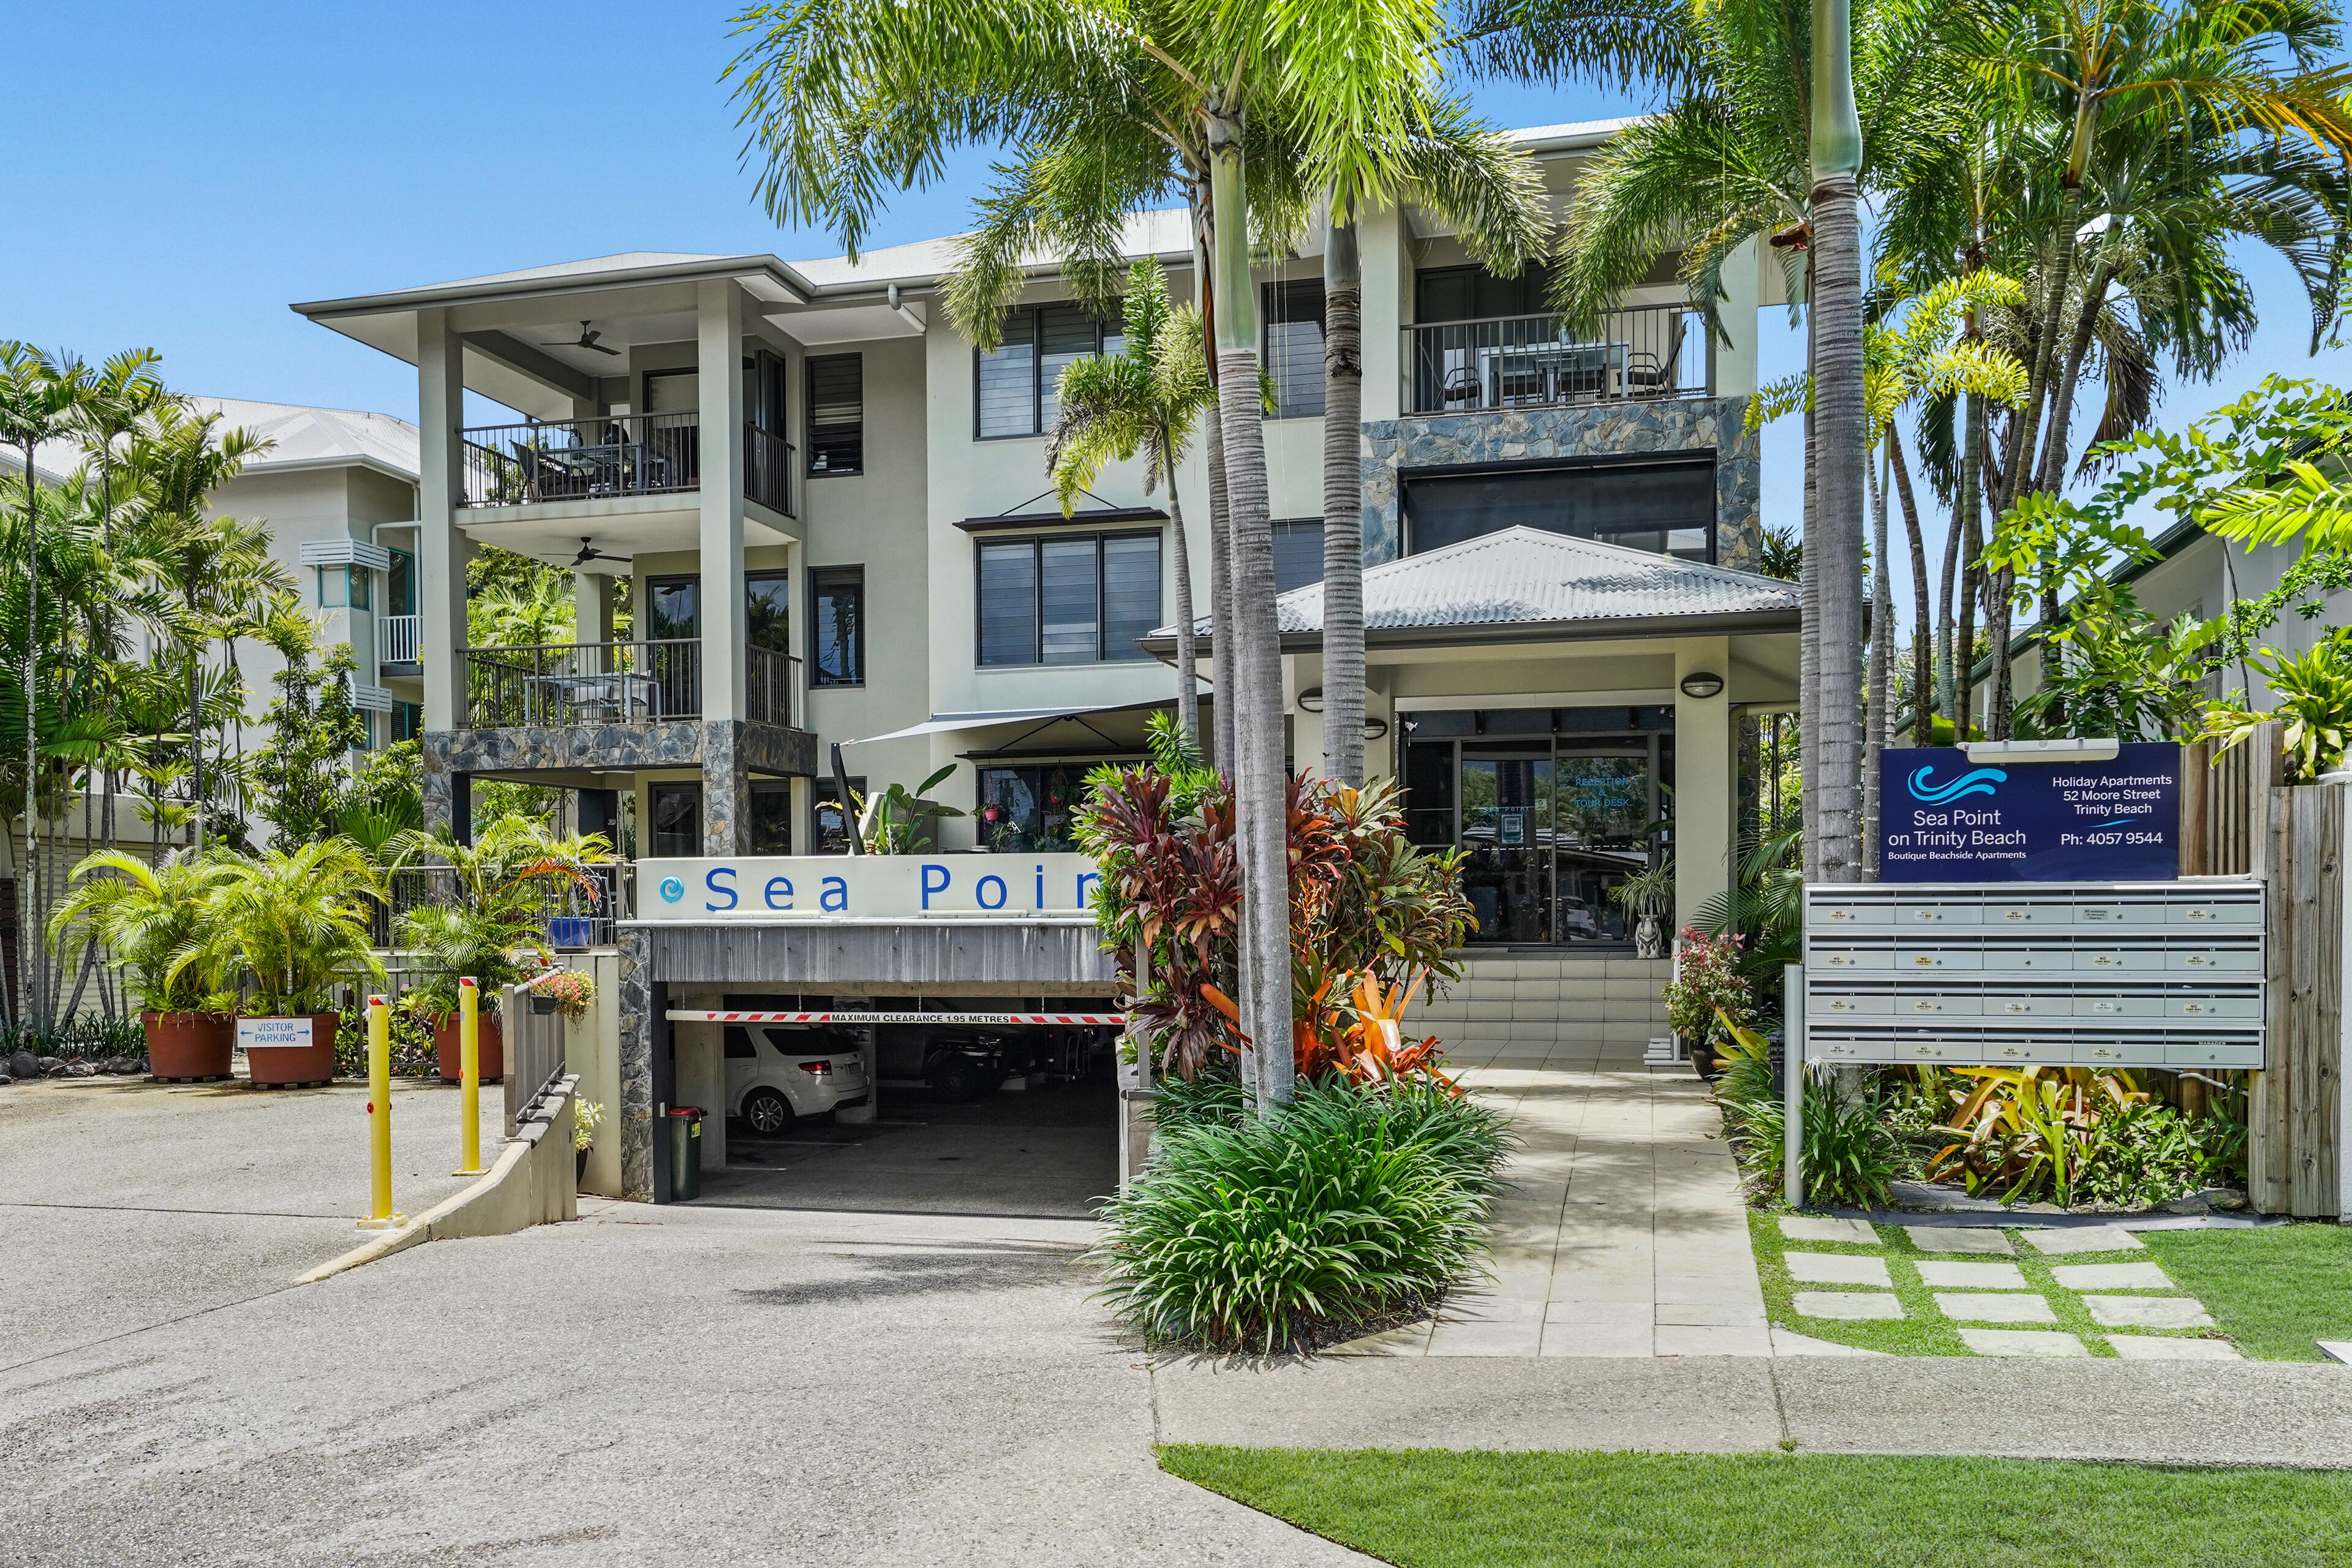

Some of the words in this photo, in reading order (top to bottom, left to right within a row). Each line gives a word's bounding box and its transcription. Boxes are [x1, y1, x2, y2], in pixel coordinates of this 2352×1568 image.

[1575, 777, 1629, 786] RECEPTION
[2053, 777, 2097, 788] Holiday
[2100, 775, 2172, 788] Apartments
[2064, 791, 2078, 801] 52
[2082, 790, 2120, 801] Moore
[2123, 789, 2160, 799] Street
[2074, 804, 2111, 816] Trinity
[2114, 804, 2152, 814] Beach
[1913, 810, 1948, 826] Sea
[1954, 810, 2001, 825] Point
[1888, 835, 1909, 846] on
[1914, 831, 1967, 848] Trinity
[1972, 830, 2026, 845] Beach
[2061, 834, 2082, 845] Ph:
[2086, 833, 2122, 845] 4057
[2126, 832, 2163, 844] 9544
[1888, 852, 1927, 861] Boutique
[1929, 851, 1973, 859] Beachside
[1975, 851, 2026, 861] Apartments
[706, 867, 848, 912] Sea
[258, 1023, 293, 1031] VISITOR
[255, 1033, 295, 1042] PARKING
